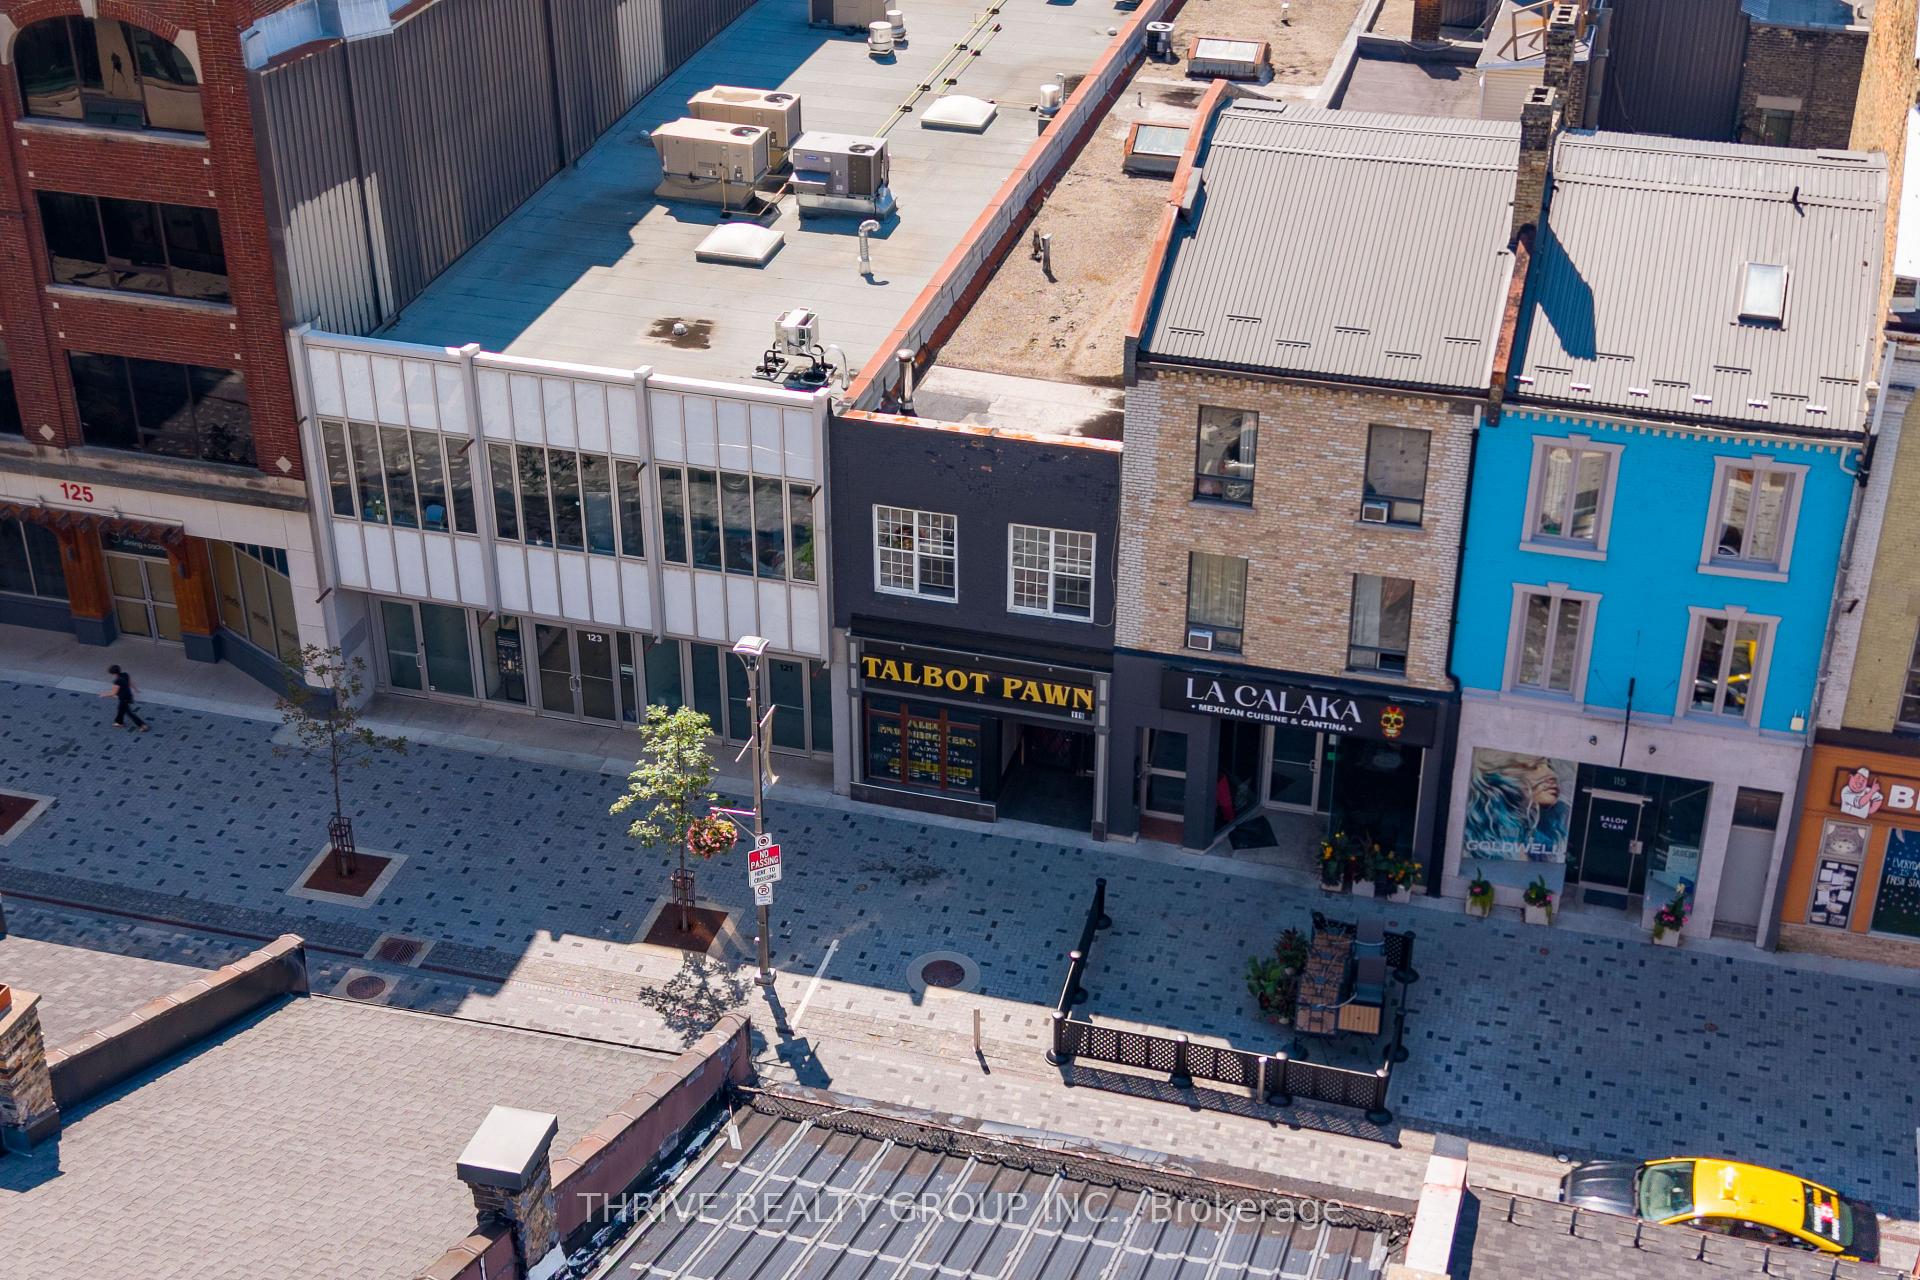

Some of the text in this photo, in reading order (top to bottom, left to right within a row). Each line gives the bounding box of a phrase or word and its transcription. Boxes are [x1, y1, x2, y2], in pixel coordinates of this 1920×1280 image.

[60, 482, 94, 503] 125
[586, 633, 602, 643] 123
[779, 663, 793, 673] 121
[862, 656, 1094, 711] TALBOT PAWN
[1186, 677, 1362, 723] LA CALAKA
[1198, 703, 1347, 732] MEXICAN CUISINE & CANTINA
[1613, 776, 1627, 787] 115
[1600, 815, 1628, 825] SALON
[1601, 822, 1624, 831] CYAN
[1466, 839, 1566, 855] GOLDWELL
[760, 849, 769, 859] NO
[750, 855, 779, 870] PASSING
[769, 866, 776, 874] TO
[753, 873, 777, 884] CROSSING
[1886, 874, 1906, 886] FRESH
